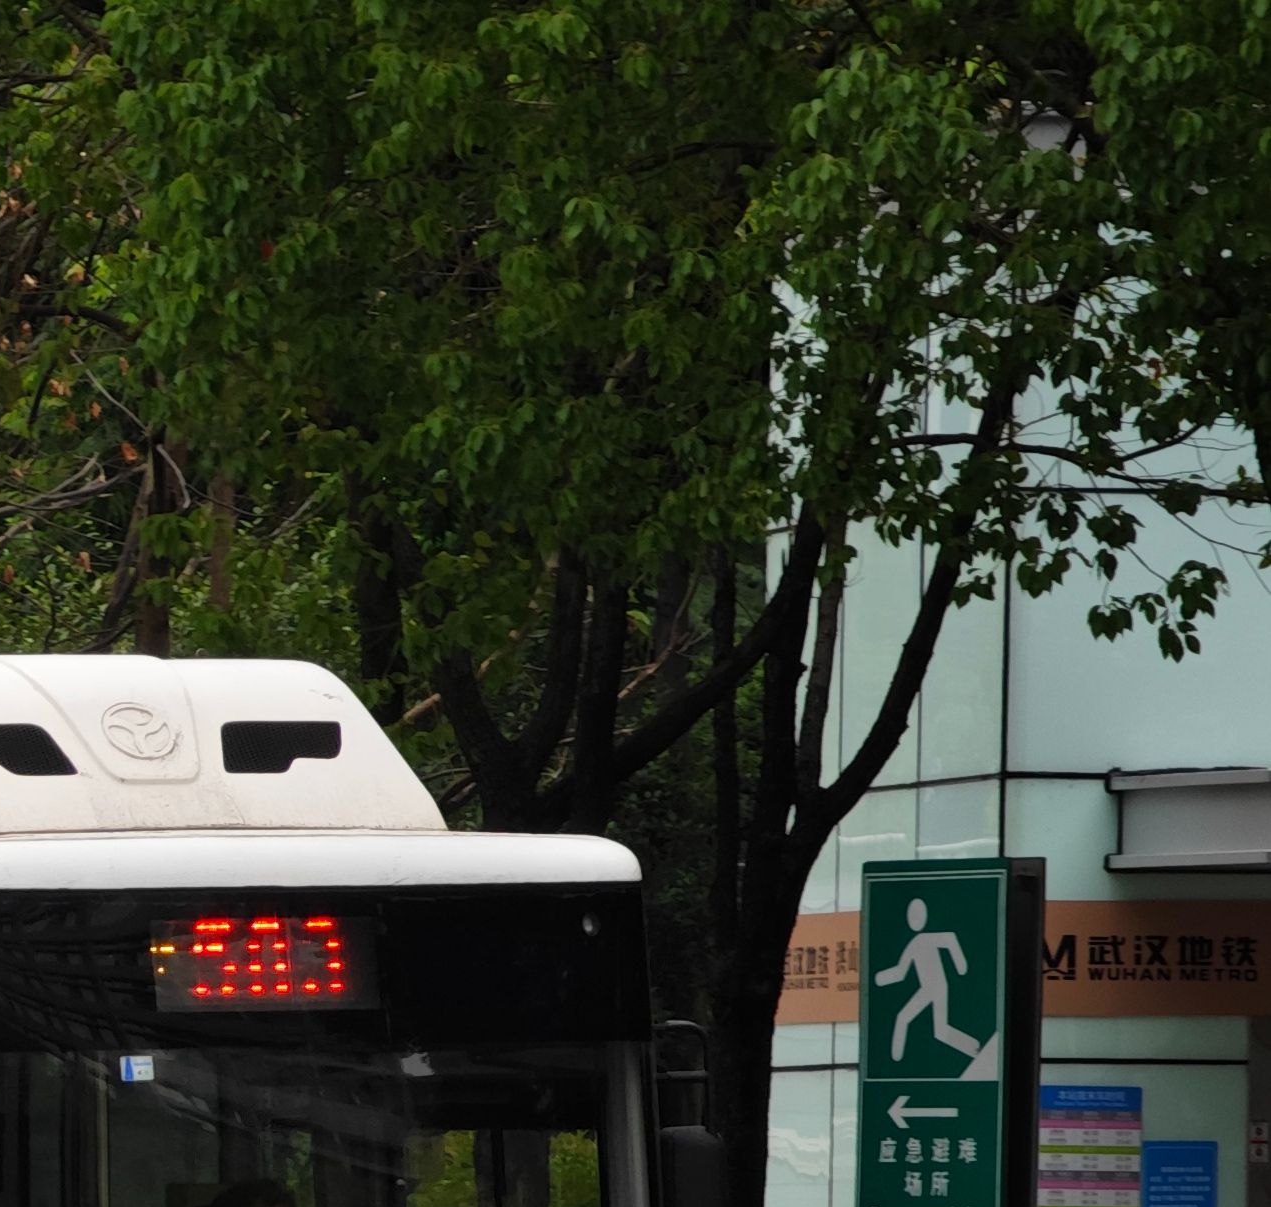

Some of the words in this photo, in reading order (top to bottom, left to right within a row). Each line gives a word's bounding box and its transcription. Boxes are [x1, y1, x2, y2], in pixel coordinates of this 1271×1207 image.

[1087, 934, 1258, 967] 武汉地铁
[1087, 967, 1172, 981] WUHAN
[1180, 967, 1259, 982] METRO
[878, 1137, 978, 1164] 应急避难
[904, 1171, 951, 1197] 场所
